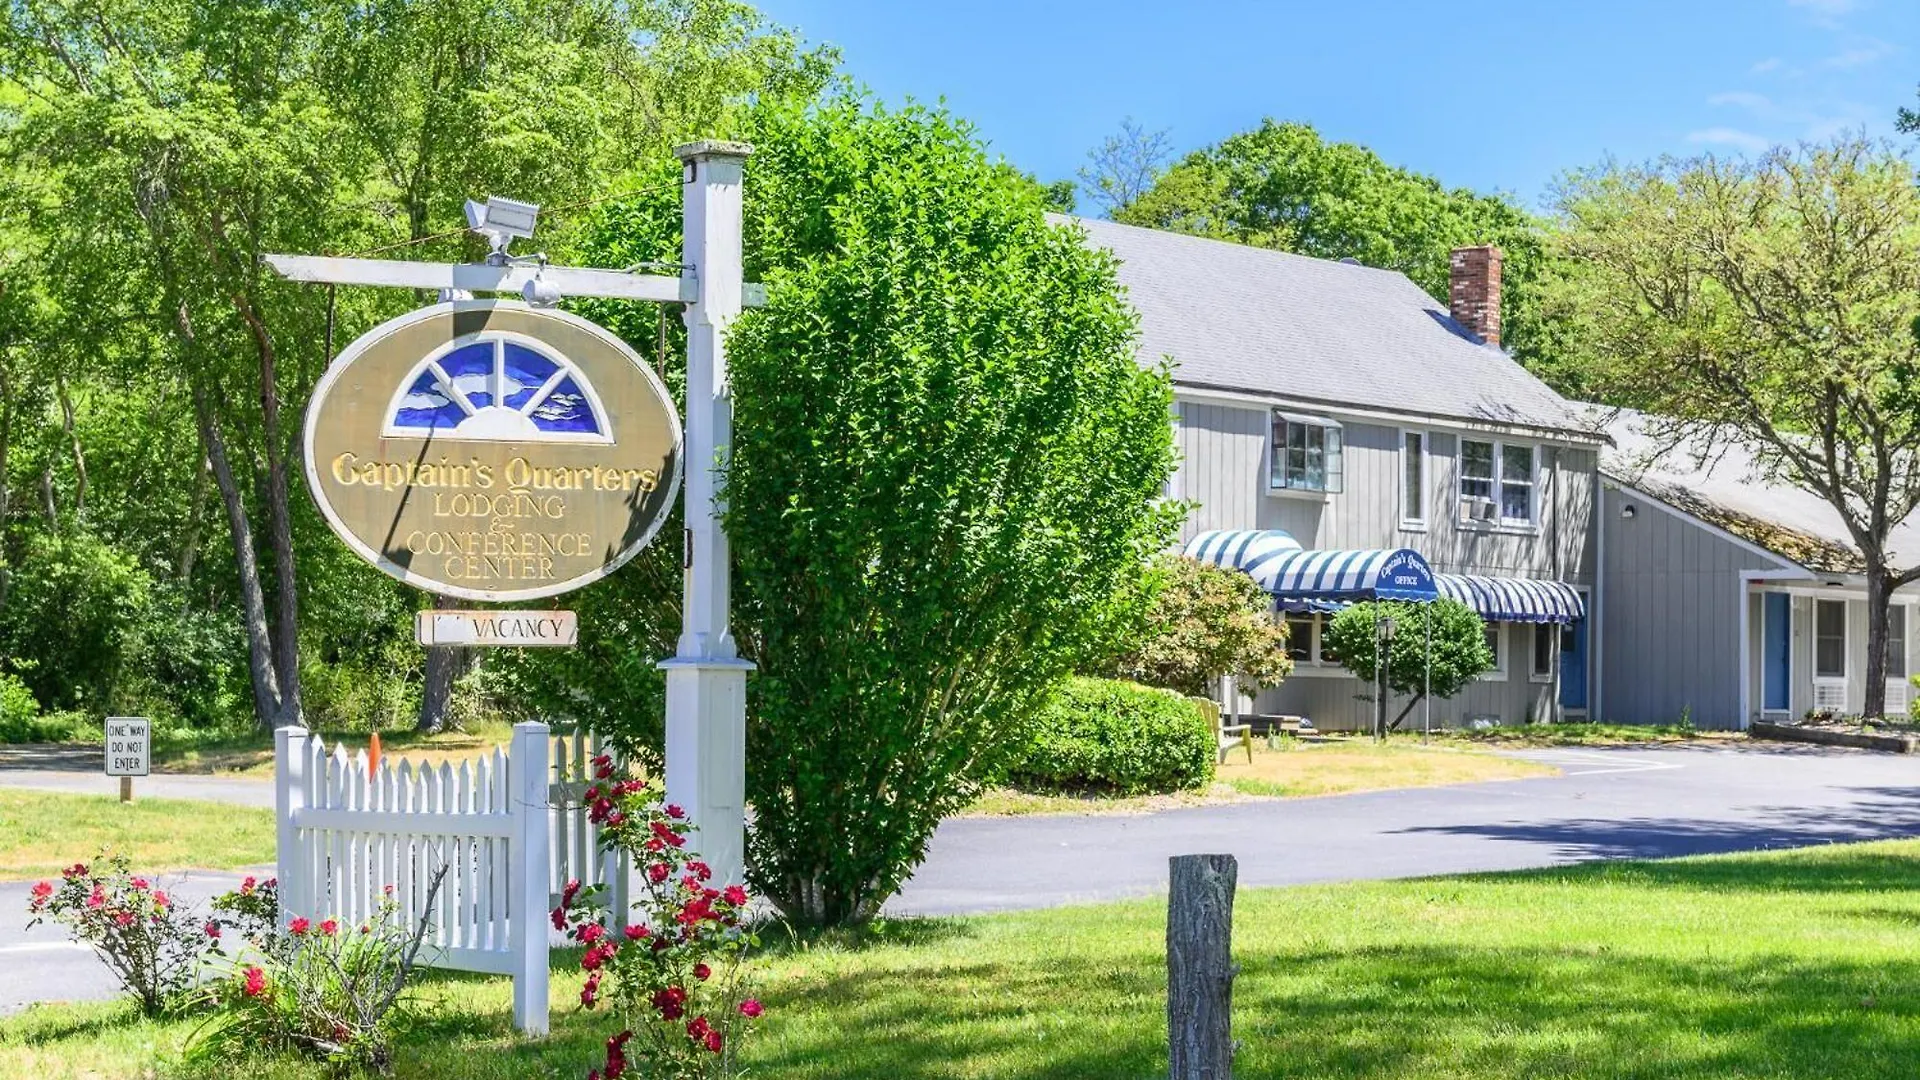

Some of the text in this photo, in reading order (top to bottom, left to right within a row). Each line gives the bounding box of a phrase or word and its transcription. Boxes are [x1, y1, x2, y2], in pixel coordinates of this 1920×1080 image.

[332, 453, 656, 494] Captain's Quarters
[434, 493, 566, 519] LODGING
[490, 518, 515, 534] &
[406, 531, 593, 557] CONFERENCE
[444, 557, 555, 580] CENTER
[1395, 575, 1417, 585] OFFICE
[472, 618, 564, 638] VACANCY
[109, 726, 145, 736] ONE WAY
[112, 742, 142, 752] DO NOT
[115, 758, 140, 769] ENTER
